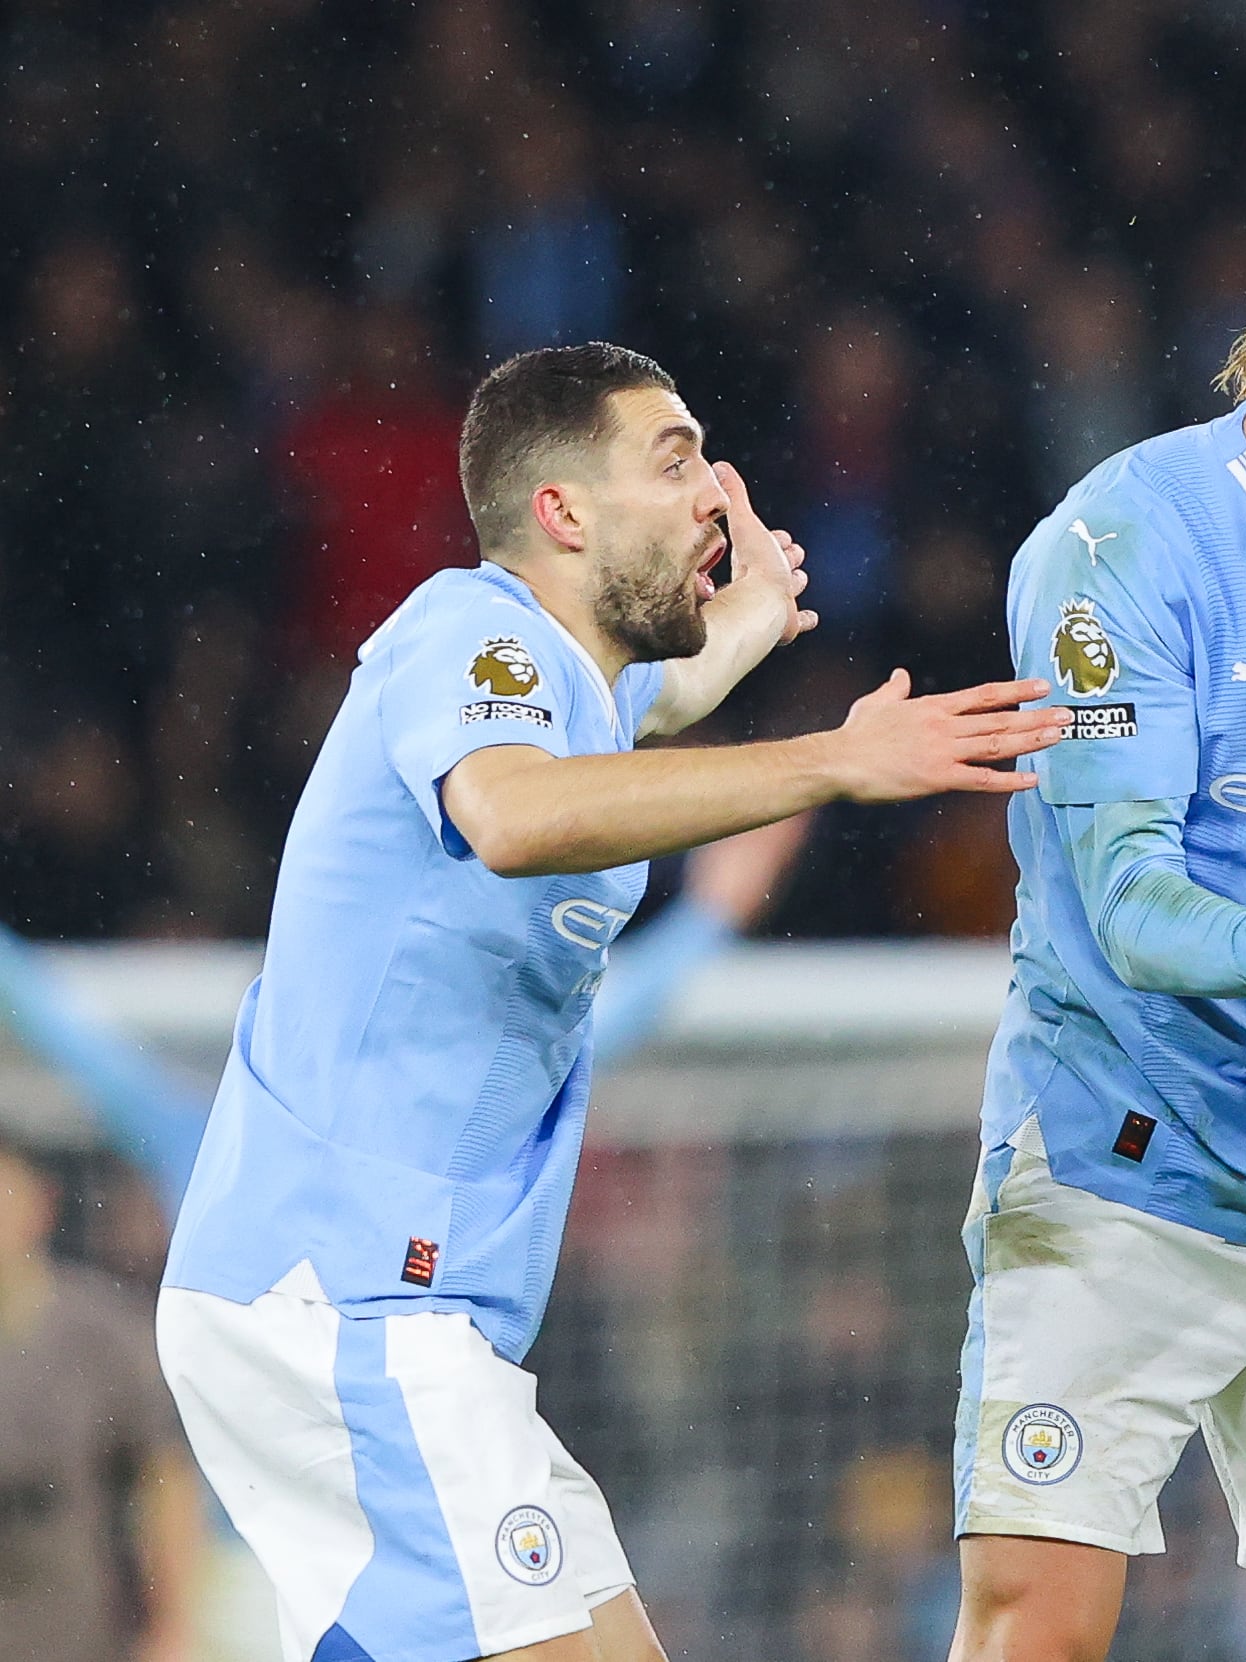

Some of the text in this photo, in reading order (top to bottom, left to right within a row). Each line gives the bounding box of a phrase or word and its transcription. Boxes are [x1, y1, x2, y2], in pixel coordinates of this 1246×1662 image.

[461, 703, 544, 719] No room
[1077, 707, 1128, 724] room
[1059, 721, 1138, 739] or racism
[1012, 1410, 1075, 1439] MANCHESTER
[1027, 1470, 1051, 1480] CITY
[501, 1511, 551, 1542] MANCHESTER
[531, 1570, 550, 1582] CITY
